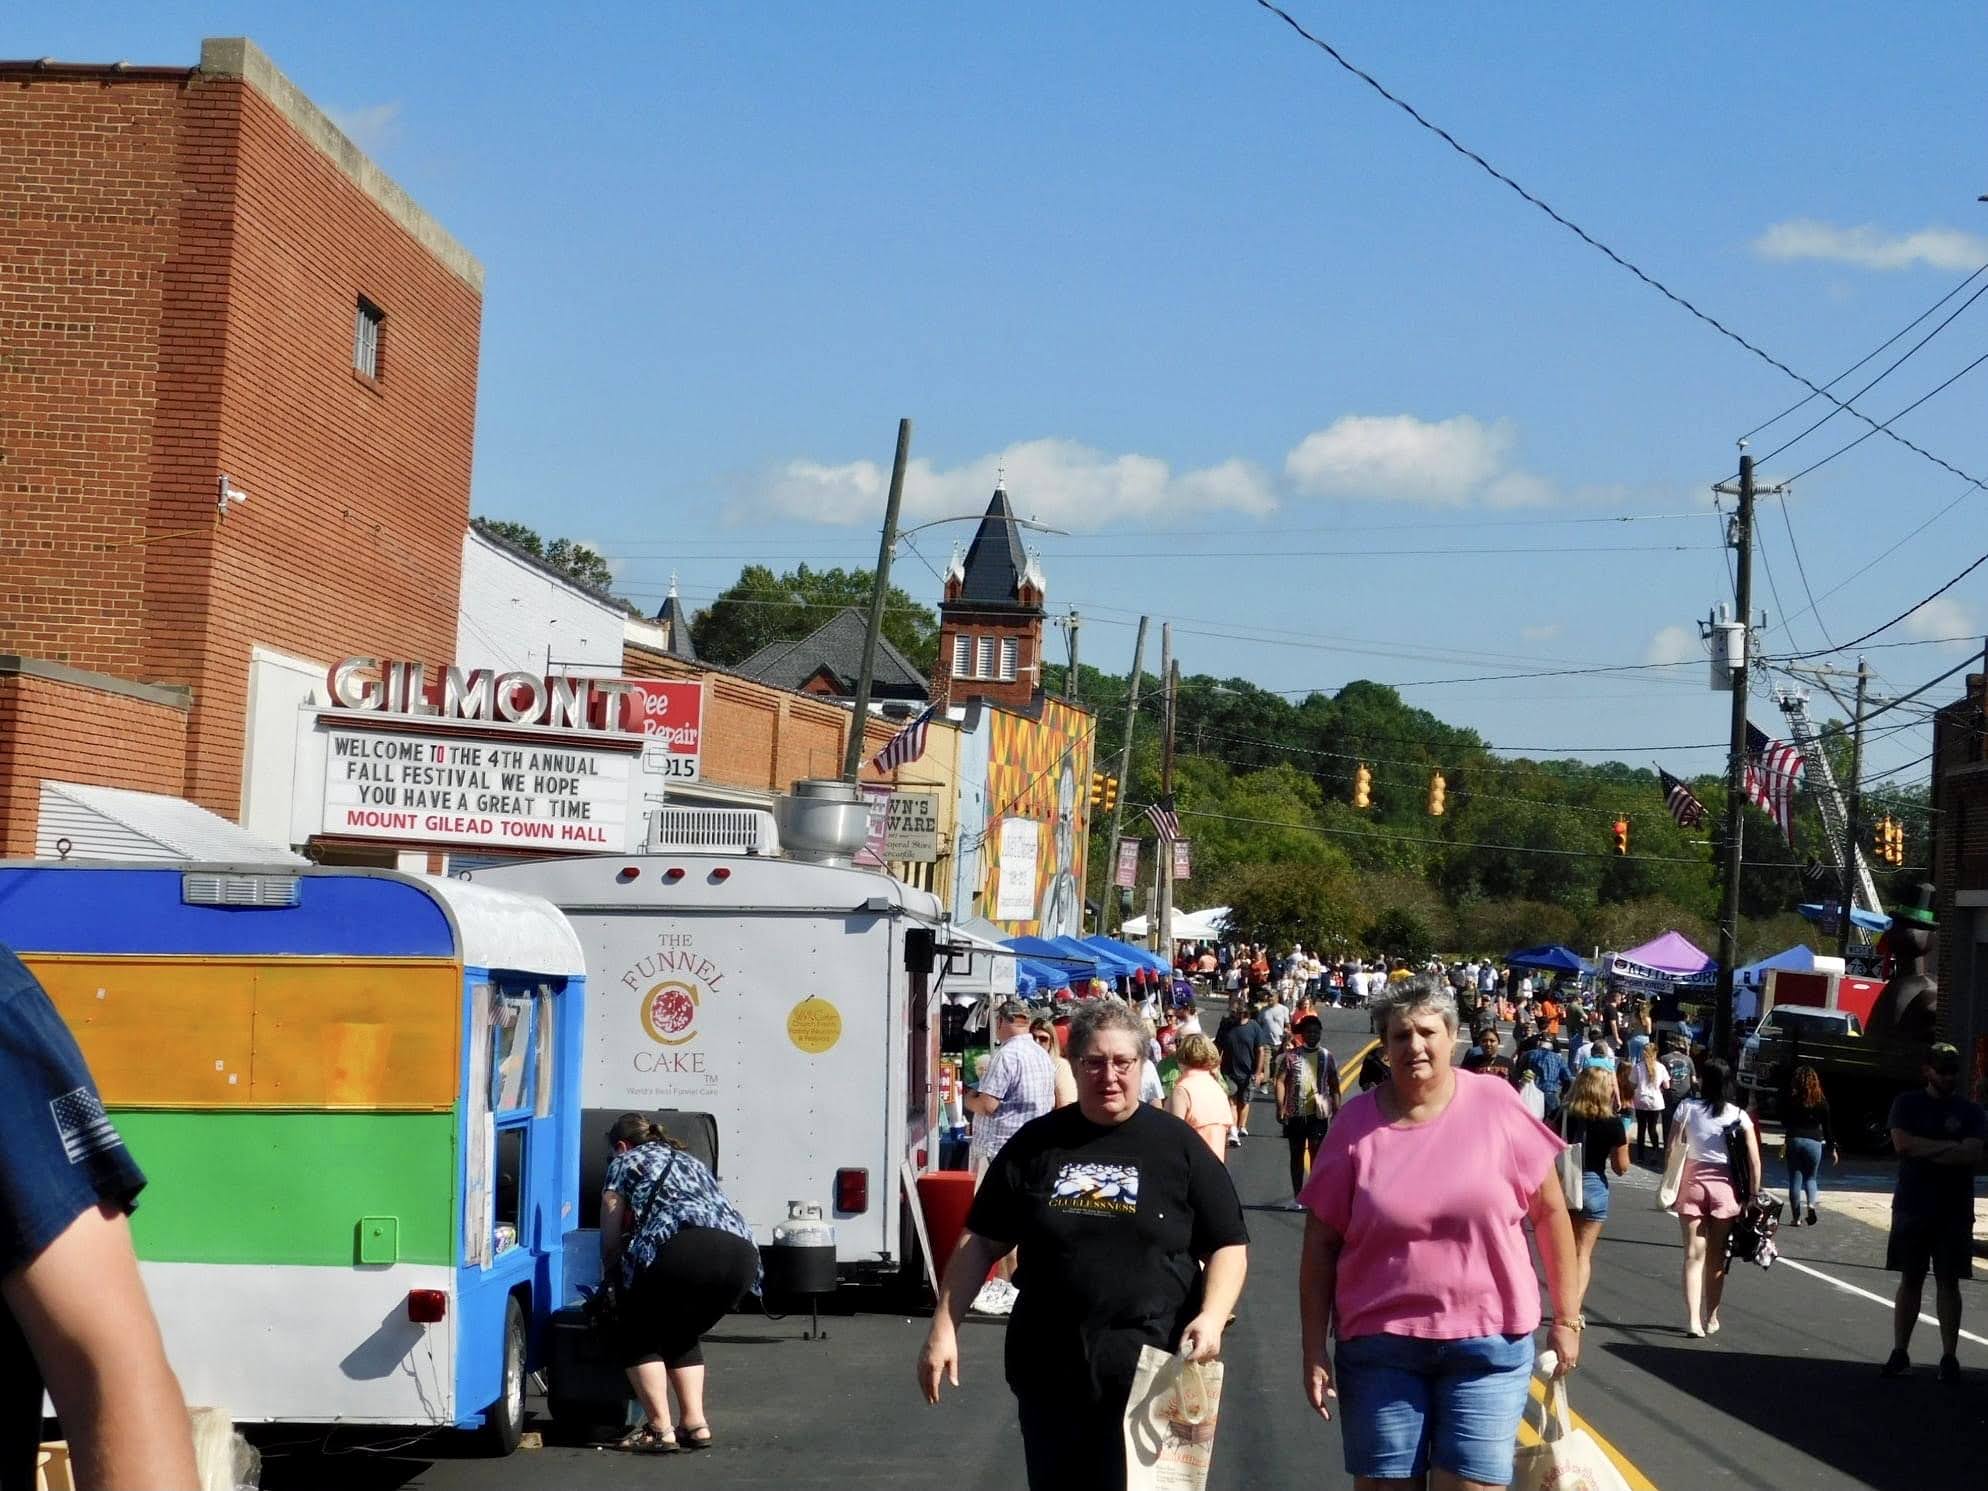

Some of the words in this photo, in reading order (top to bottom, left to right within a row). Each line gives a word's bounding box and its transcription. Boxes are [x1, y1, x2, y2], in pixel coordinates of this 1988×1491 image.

[327, 656, 633, 733] GILMONT
[335, 737, 423, 762] WELCOME
[430, 745, 445, 763] TO
[449, 747, 482, 766] THE
[487, 750, 523, 769] 4TH
[529, 753, 598, 775] ANNUAL
[347, 761, 394, 782] FALL
[402, 766, 490, 790] FESTIVAL
[501, 773, 526, 792] WE
[534, 775, 580, 795] HOPE
[359, 785, 396, 805] YOU
[403, 788, 452, 809] HAVE
[457, 793, 468, 811] A
[477, 794, 535, 815] GREAT
[549, 799, 591, 819] TIME
[347, 810, 418, 829] MOUNT
[425, 815, 493, 834] GILEAD
[500, 821, 554, 839] TOWN
[561, 825, 607, 842] HALL
[658, 934, 693, 947] THE
[621, 951, 725, 993] FUNNEL
[633, 1051, 706, 1073] CAKE
